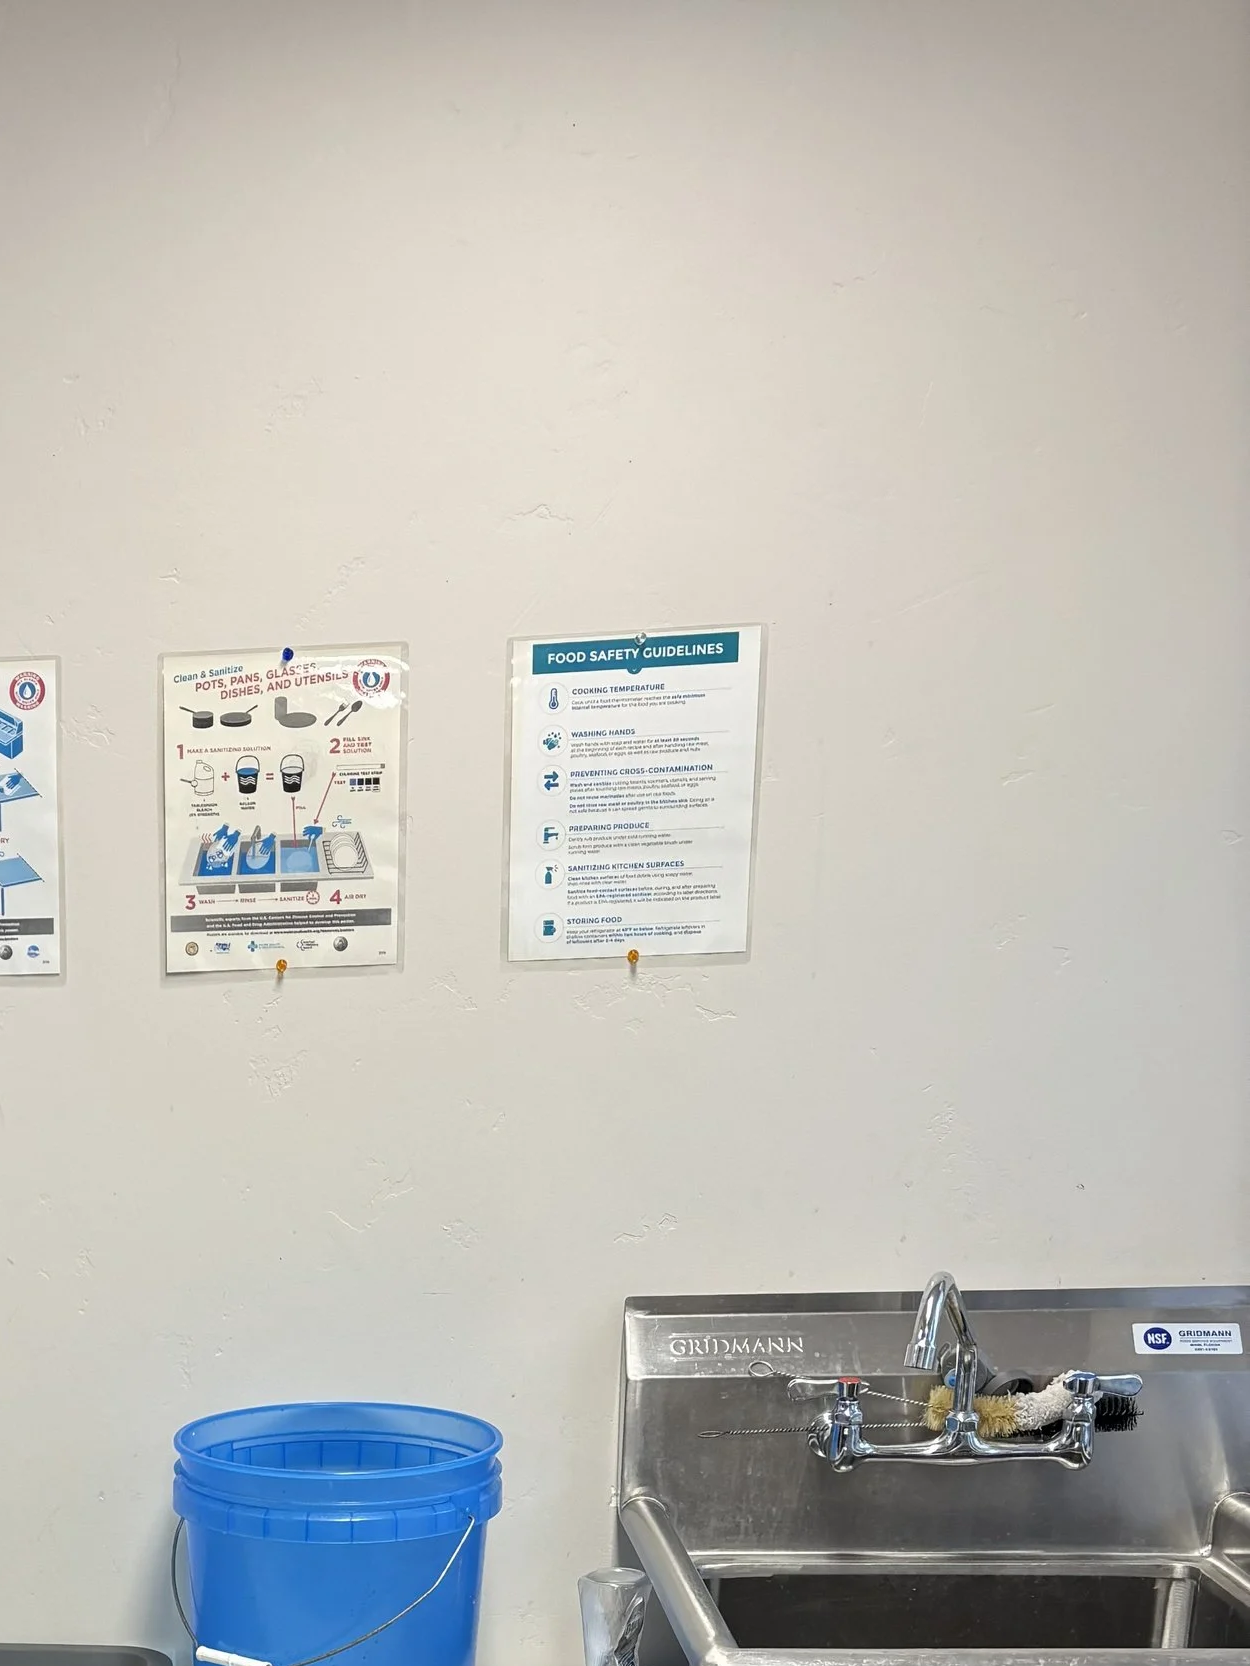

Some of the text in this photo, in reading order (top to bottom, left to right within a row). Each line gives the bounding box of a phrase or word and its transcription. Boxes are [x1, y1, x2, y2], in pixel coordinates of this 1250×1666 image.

[548, 643, 724, 664] FOOD SAFETY GUIDELINES
[174, 674, 198, 683] Clean
[209, 664, 243, 677] Sanitize
[195, 679, 227, 692] POTS,
[230, 673, 263, 688] PANS,
[220, 670, 348, 700] DISHES, AND UTENSILS
[572, 684, 665, 695] COOKING TEMPERATURE
[571, 730, 607, 738] WASHING
[177, 744, 183, 759] 1
[329, 738, 340, 754] 2
[570, 764, 713, 778] PREVENTING CROSS-CONTAMINATION
[569, 822, 650, 832] PREPARING PRODUCE
[568, 863, 610, 872] SANITIZING
[185, 895, 196, 910] 3
[330, 889, 342, 905] 4
[567, 917, 599, 925] STORING
[670, 1337, 804, 1355] GRIDMANN
[1147, 1333, 1167, 1344] NSF
